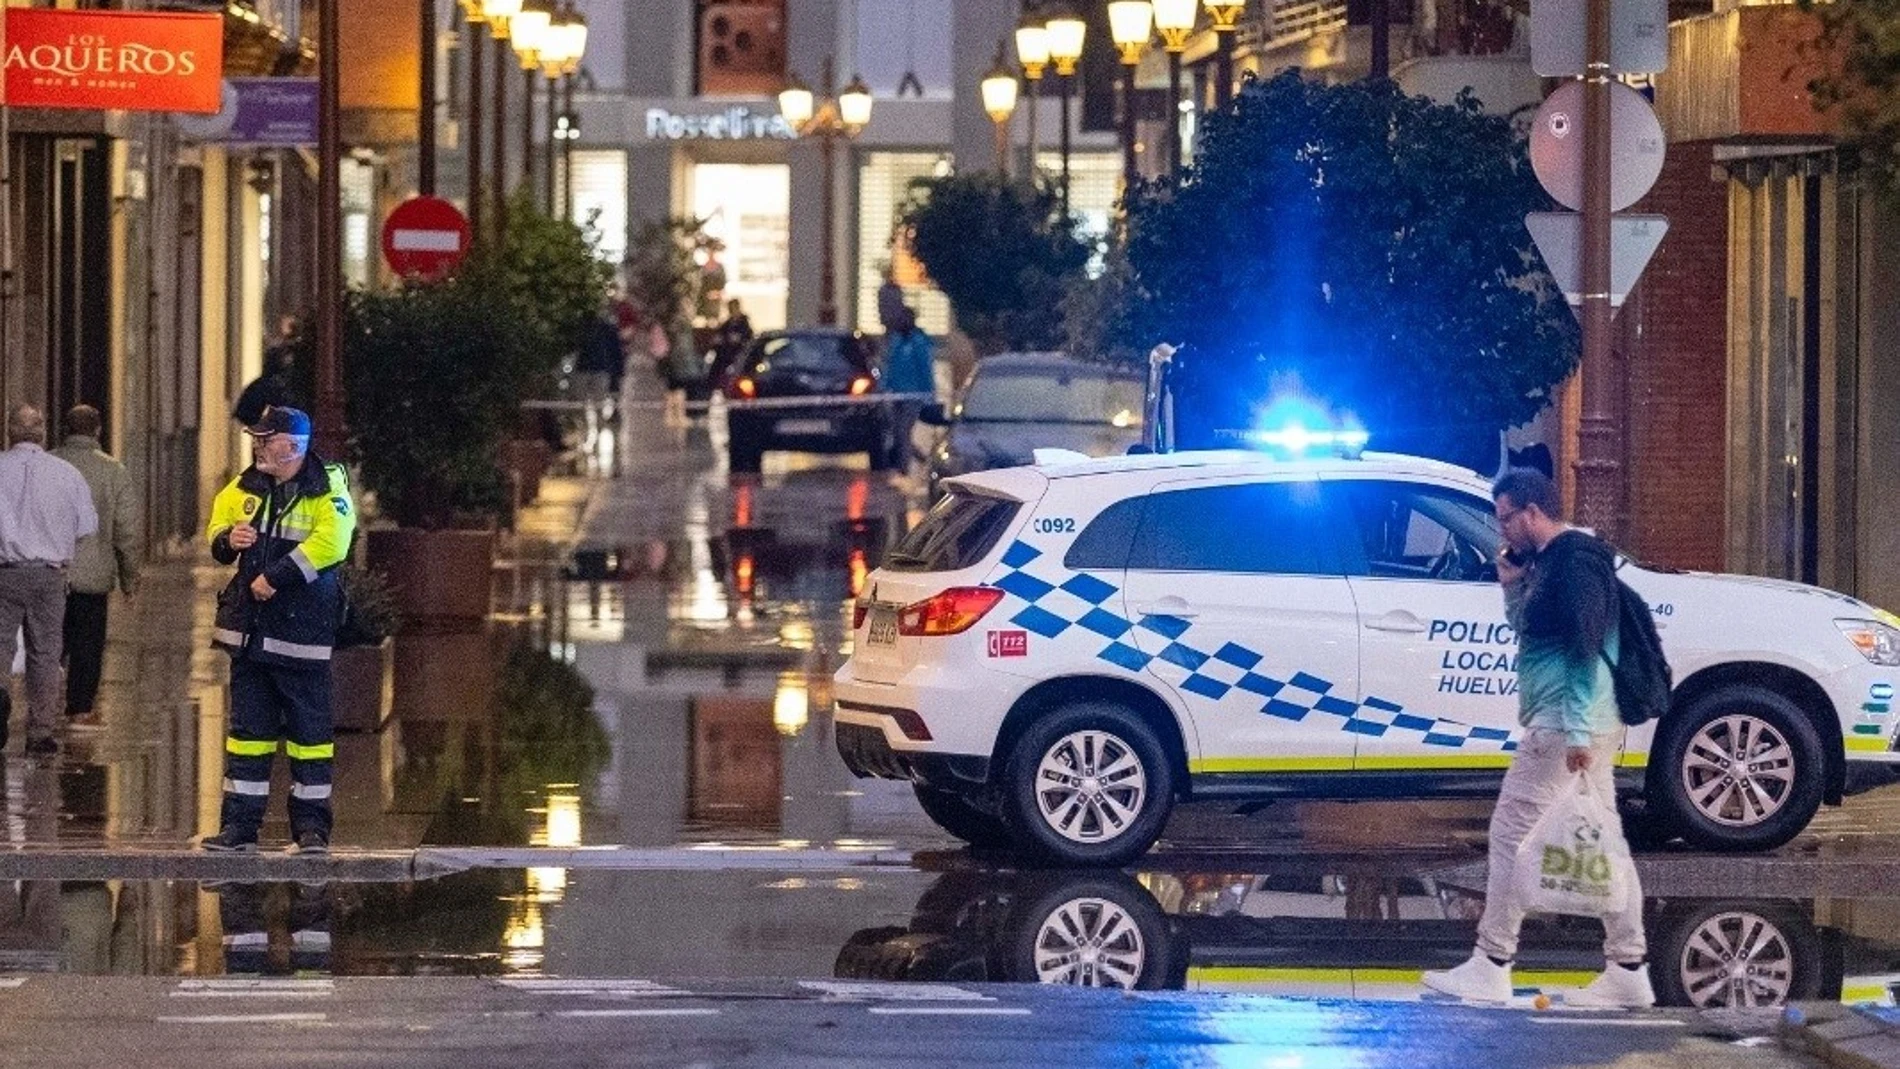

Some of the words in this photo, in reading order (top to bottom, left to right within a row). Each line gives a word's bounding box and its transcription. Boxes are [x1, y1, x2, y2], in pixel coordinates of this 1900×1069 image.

[68, 34, 106, 46] LOS
[4, 43, 196, 77] AQUEROS
[1042, 518, 1076, 533] 092
[1648, 603, 1674, 616] -40
[1428, 619, 1521, 646] POLICI
[1003, 635, 1025, 647] 112
